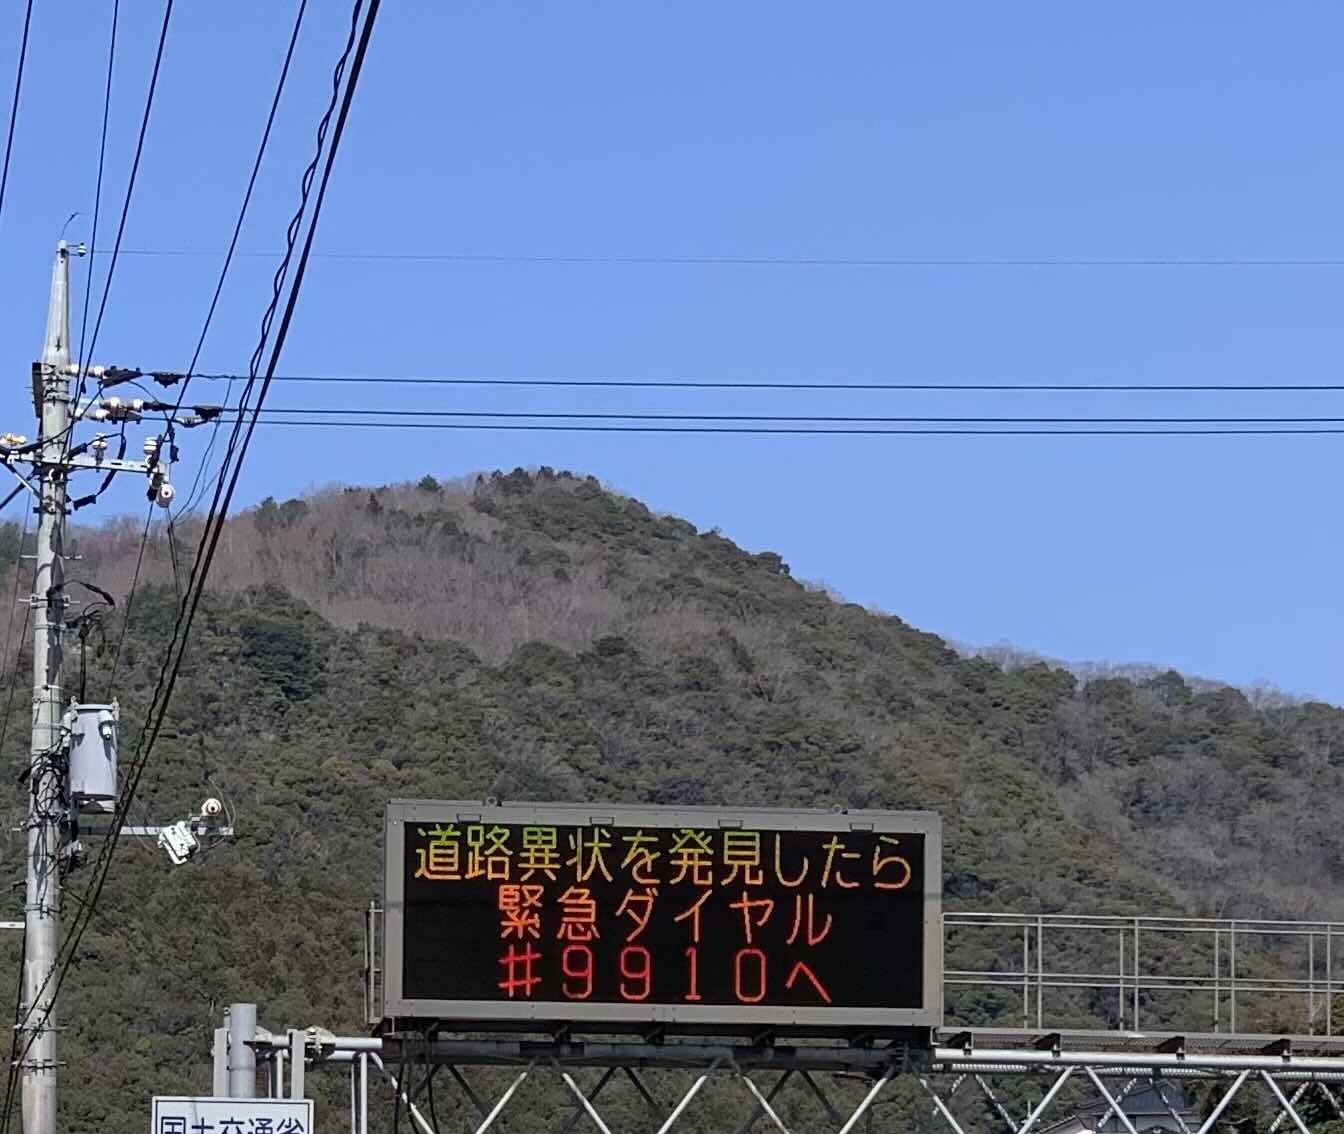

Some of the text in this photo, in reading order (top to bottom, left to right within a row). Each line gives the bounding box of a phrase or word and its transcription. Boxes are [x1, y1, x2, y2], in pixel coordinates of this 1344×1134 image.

[414, 823, 912, 889] 道路異状を発見したら
[497, 884, 833, 947] 緊急ダイヤル
